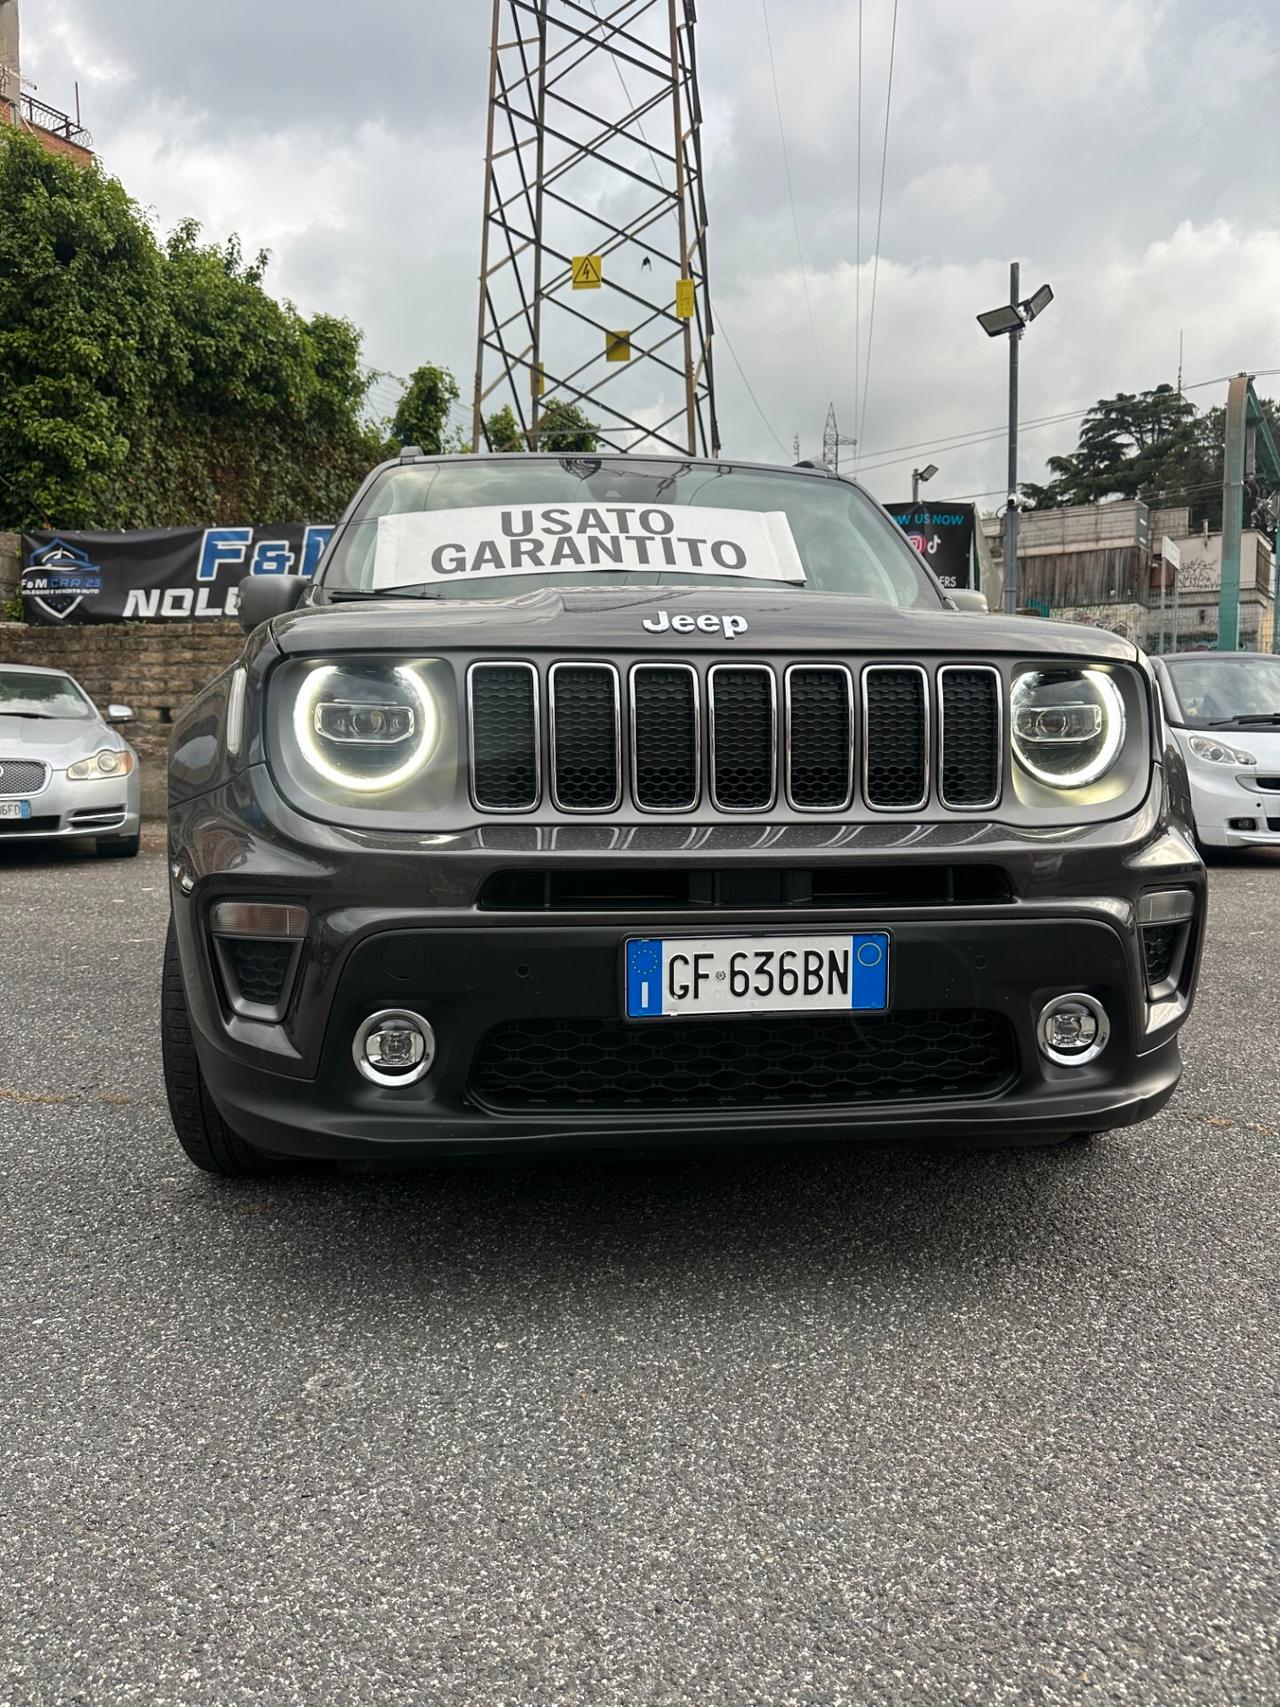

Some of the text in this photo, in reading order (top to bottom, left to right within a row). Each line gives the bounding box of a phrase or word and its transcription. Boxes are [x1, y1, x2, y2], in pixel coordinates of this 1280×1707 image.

[500, 508, 675, 538] USATO
[915, 514, 930, 525] US
[933, 514, 965, 525] NOW
[430, 535, 748, 575] GARANTITO
[51, 578, 81, 588] CAR
[642, 610, 749, 640] Jeep
[668, 950, 849, 1000] GF 636BN
